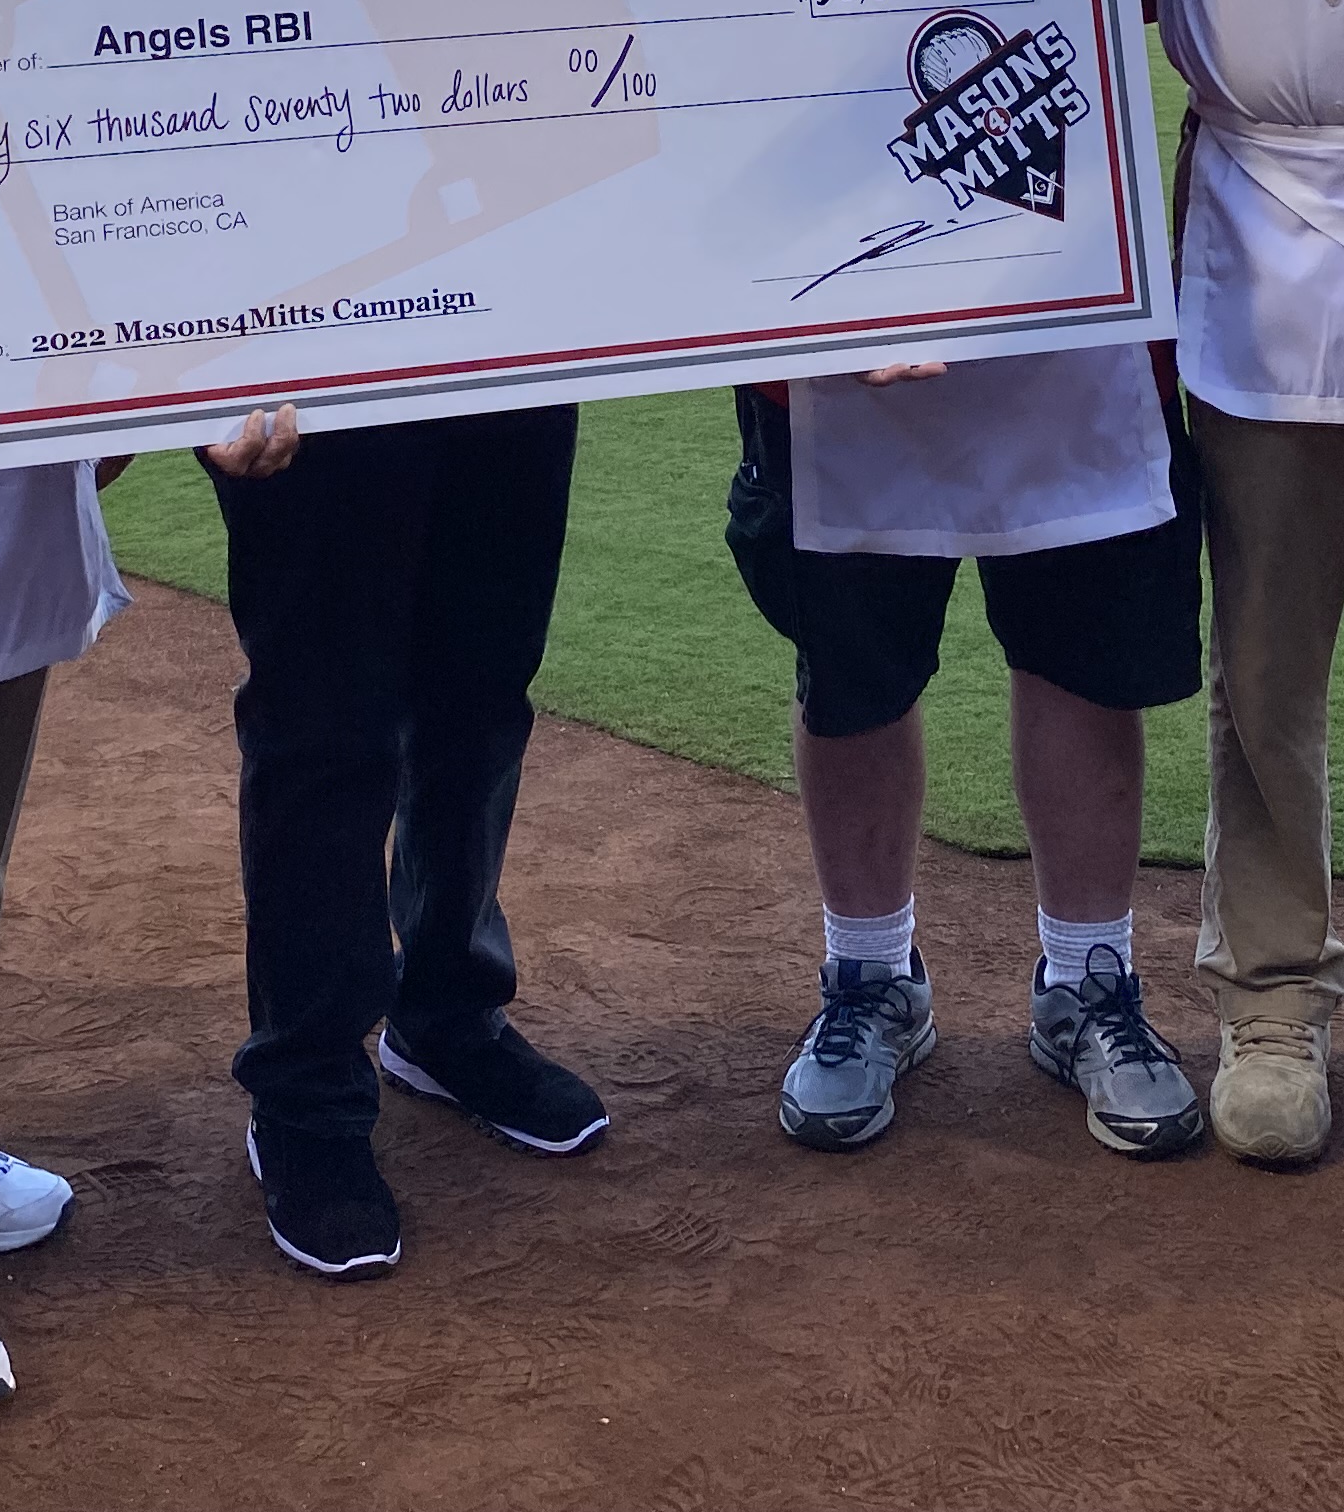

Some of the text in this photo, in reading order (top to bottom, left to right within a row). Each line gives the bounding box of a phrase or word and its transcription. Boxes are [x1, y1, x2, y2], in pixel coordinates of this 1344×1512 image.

[94, 10, 313, 60] Angels RBI
[25, 114, 73, 151] six
[87, 92, 230, 144] thousand
[368, 83, 422, 120] two
[441, 69, 529, 114] dollars
[887, 20, 1077, 183] MASONS
[939, 76, 1091, 211] MITTS
[53, 191, 225, 224] Bank of America
[54, 210, 248, 247] San Francisco, CA
[31, 328, 107, 355] 2022
[115, 302, 326, 345] Masons4Mitts
[333, 288, 477, 322] Campaign
